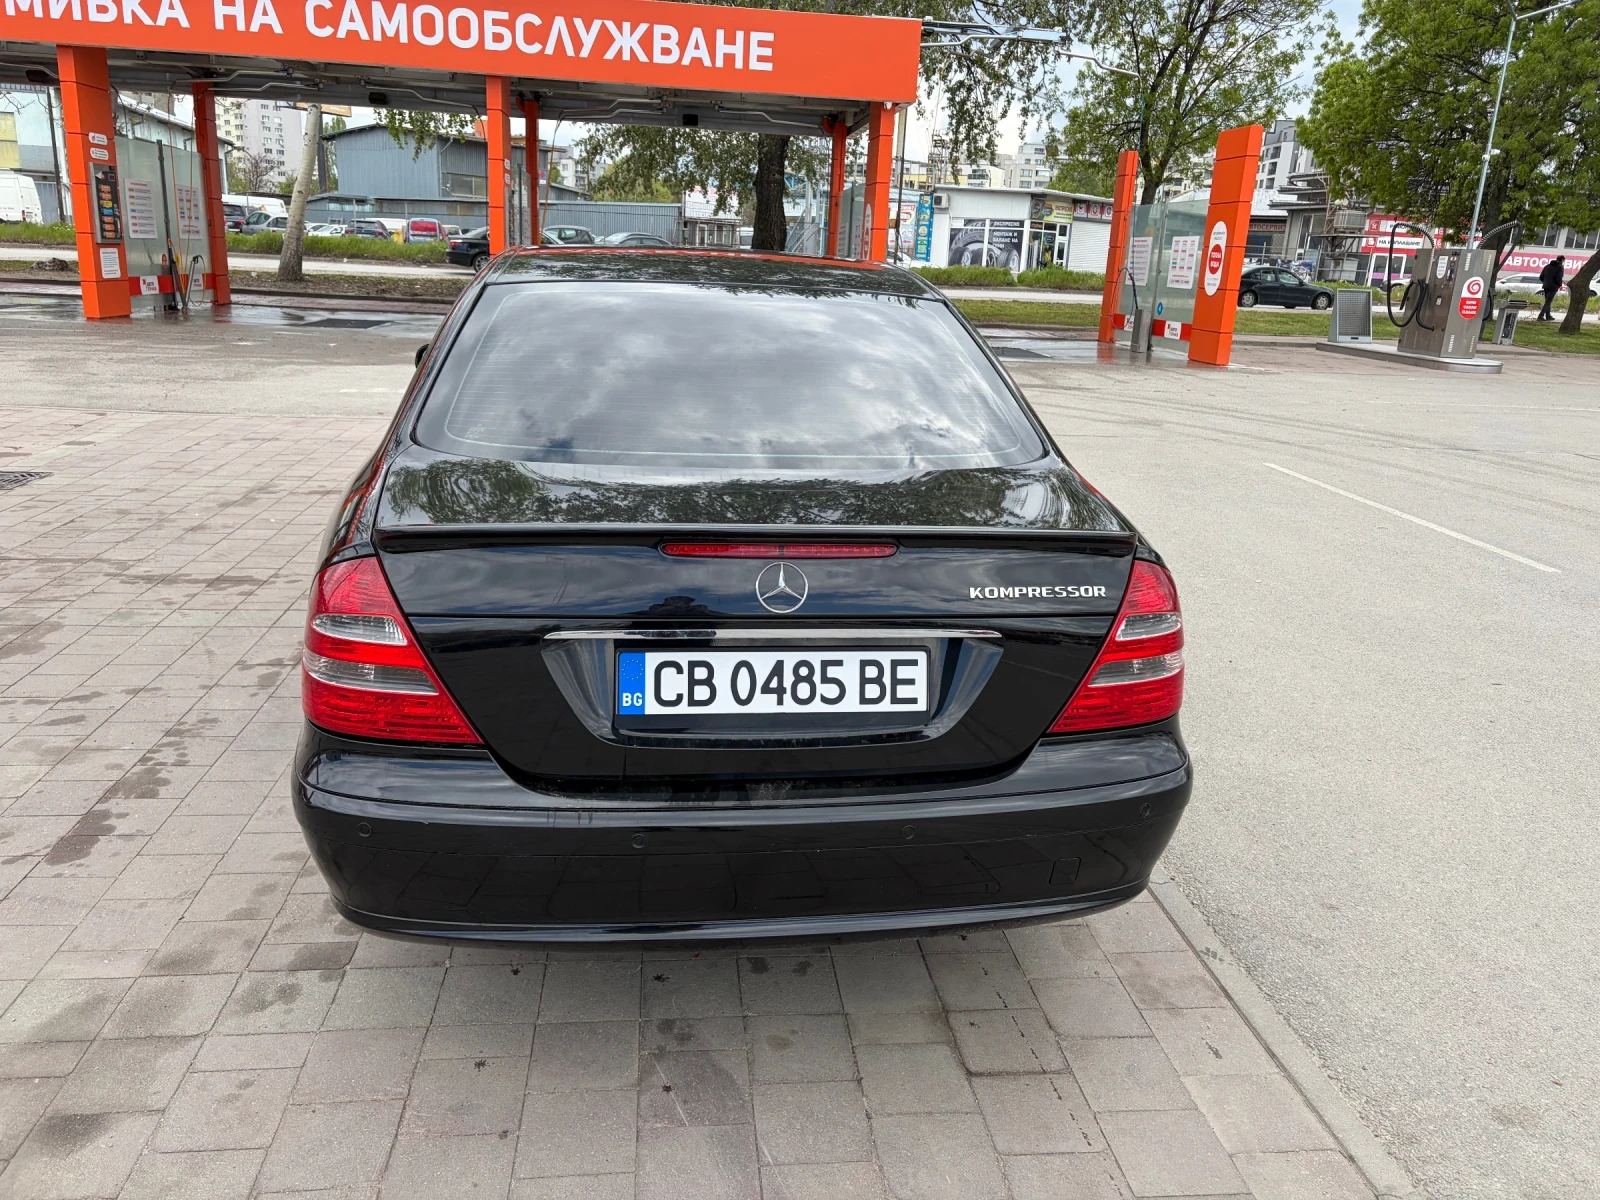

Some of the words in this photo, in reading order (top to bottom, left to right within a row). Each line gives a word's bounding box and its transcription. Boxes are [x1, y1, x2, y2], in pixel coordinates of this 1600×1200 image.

[213, 0, 284, 35] НА
[304, 0, 775, 72] САМООБСЛУЖВАНЕ
[1249, 223, 1287, 231] ВТОСЕРВИЗ
[1504, 256, 1588, 270] АВТОСВИ
[969, 585, 1107, 599] KOMPRESSOR
[653, 659, 718, 708] CB
[730, 659, 847, 707] 0485
[859, 659, 919, 706] BE
[622, 692, 643, 707] BG
